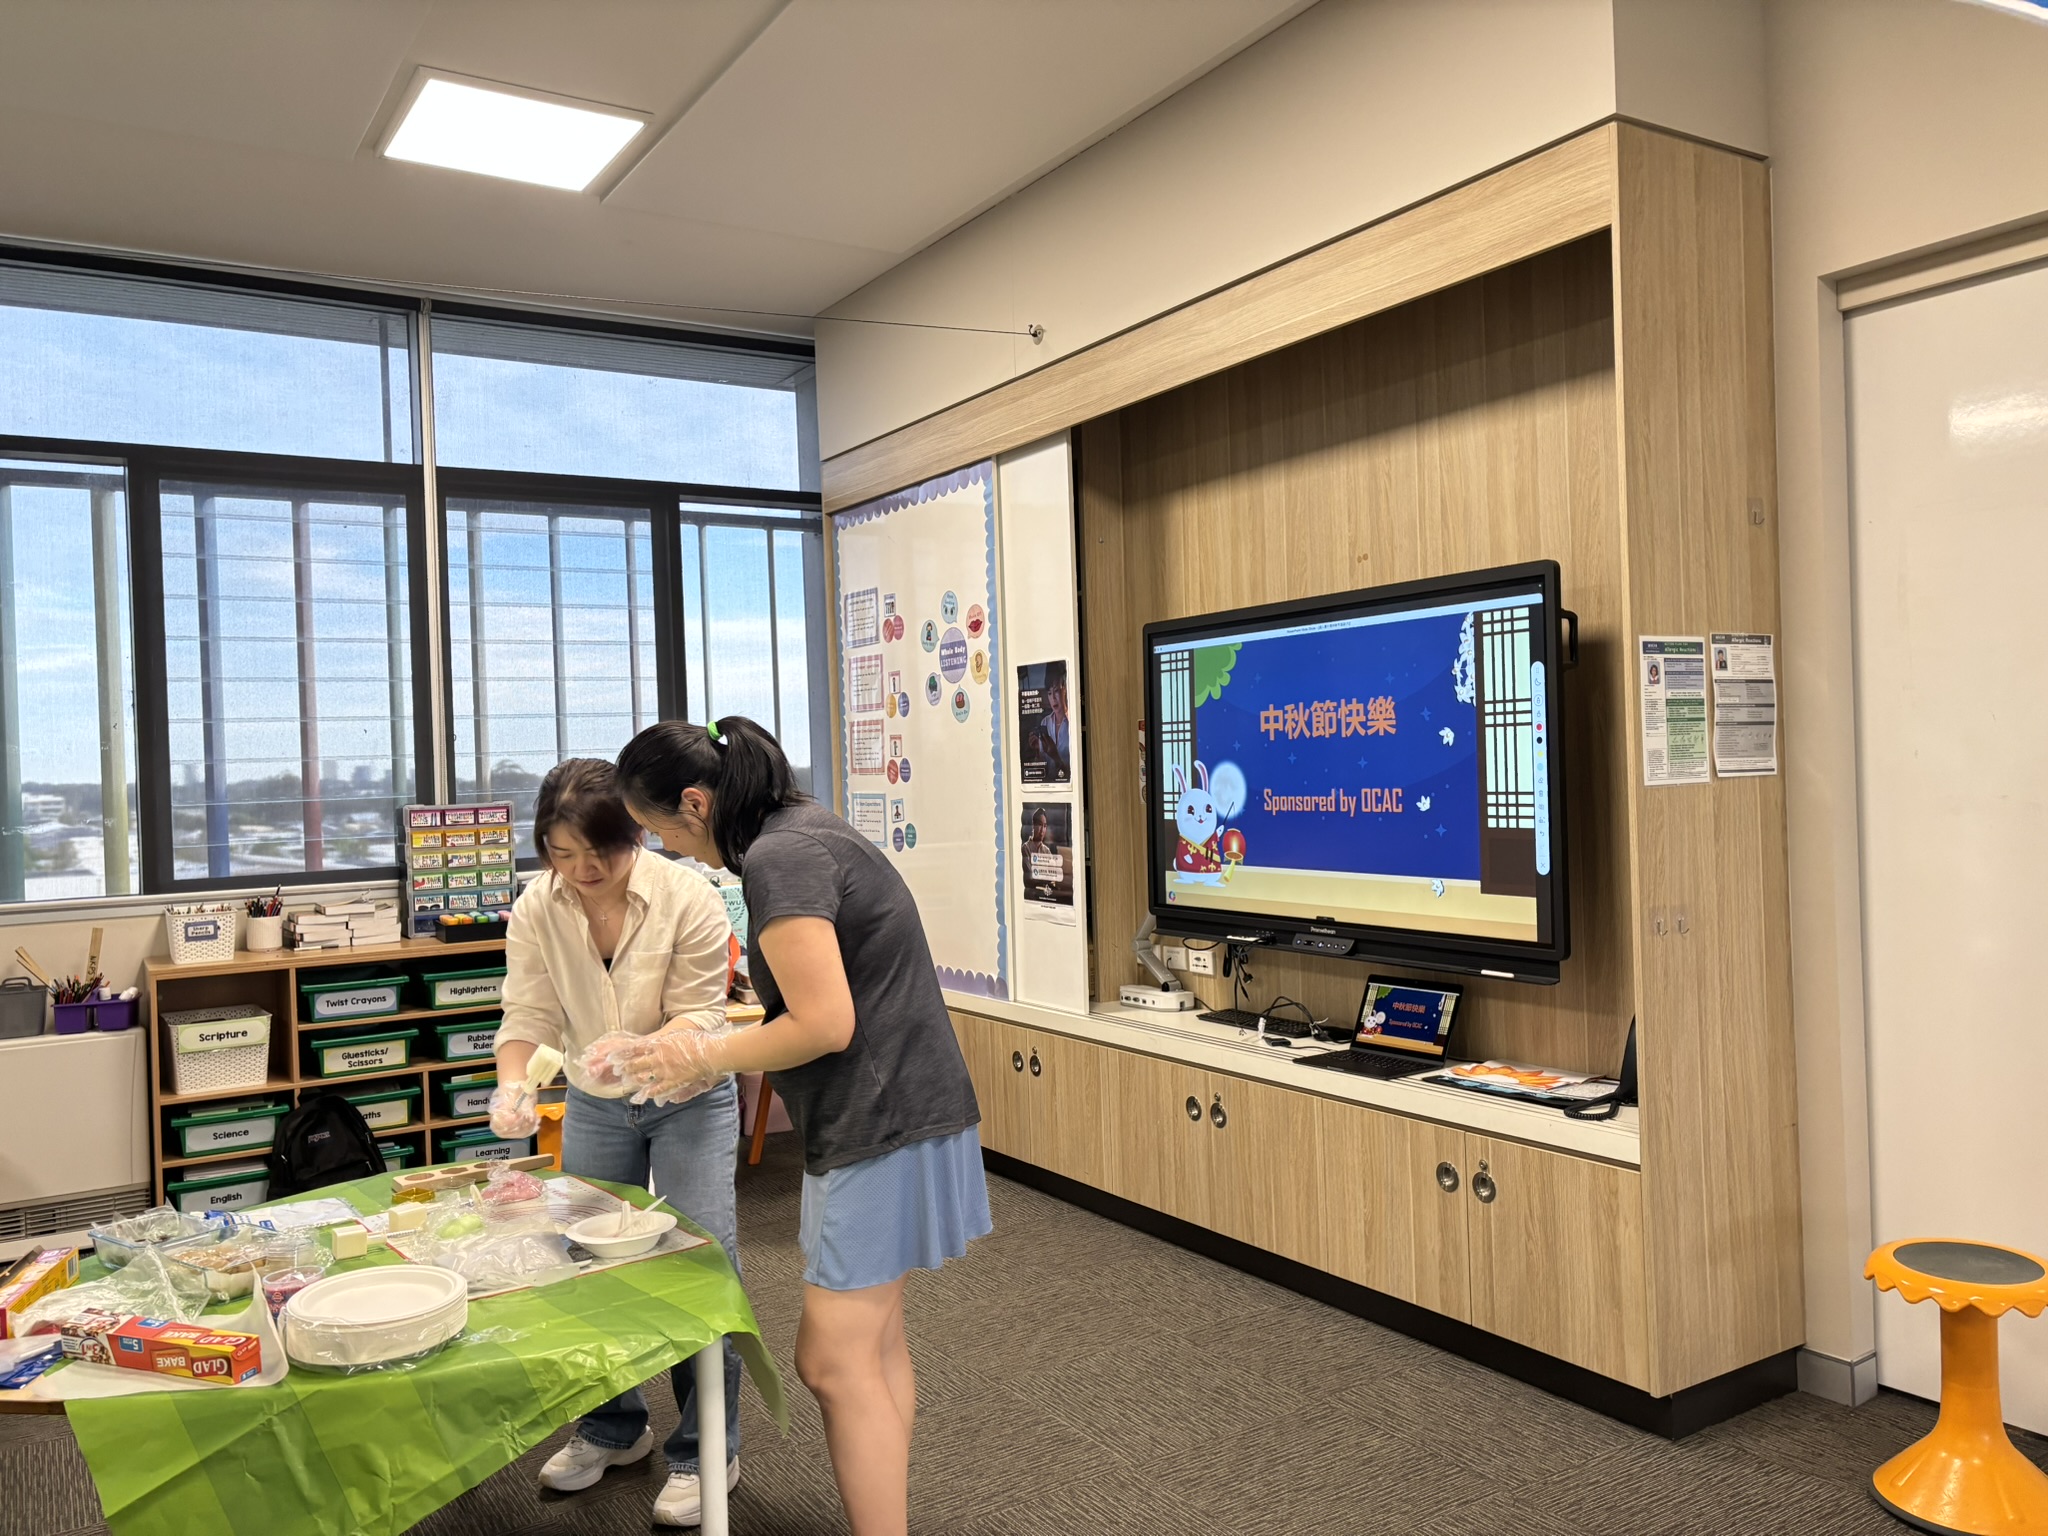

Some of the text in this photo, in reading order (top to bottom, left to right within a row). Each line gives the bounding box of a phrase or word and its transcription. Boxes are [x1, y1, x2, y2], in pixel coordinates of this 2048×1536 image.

[955, 645, 966, 653] Body
[941, 656, 966, 667] LISTENING
[1260, 696, 1397, 741] 中秋節快樂
[1264, 788, 1403, 817] Sponsored by OCAC
[450, 986, 496, 996] Highlighters
[326, 995, 386, 1008] Twist Crayons
[1392, 1002, 1426, 1013] 中秋節快樂
[199, 1030, 248, 1042] Scripture
[342, 1048, 388, 1060] Gluesticks/
[348, 1058, 383, 1068] Scissors
[363, 1110, 381, 1120] aths
[212, 1128, 249, 1140] Science
[476, 1147, 510, 1157] Learning
[210, 1192, 242, 1205] English
[160, 1330, 247, 1344] GLAD BAKE
[82, 1344, 87, 1356] 1
[93, 1344, 99, 1355] 3
[132, 1338, 138, 1350] 5
[156, 1356, 186, 1368] BAKE
[193, 1358, 228, 1375] GLAD
